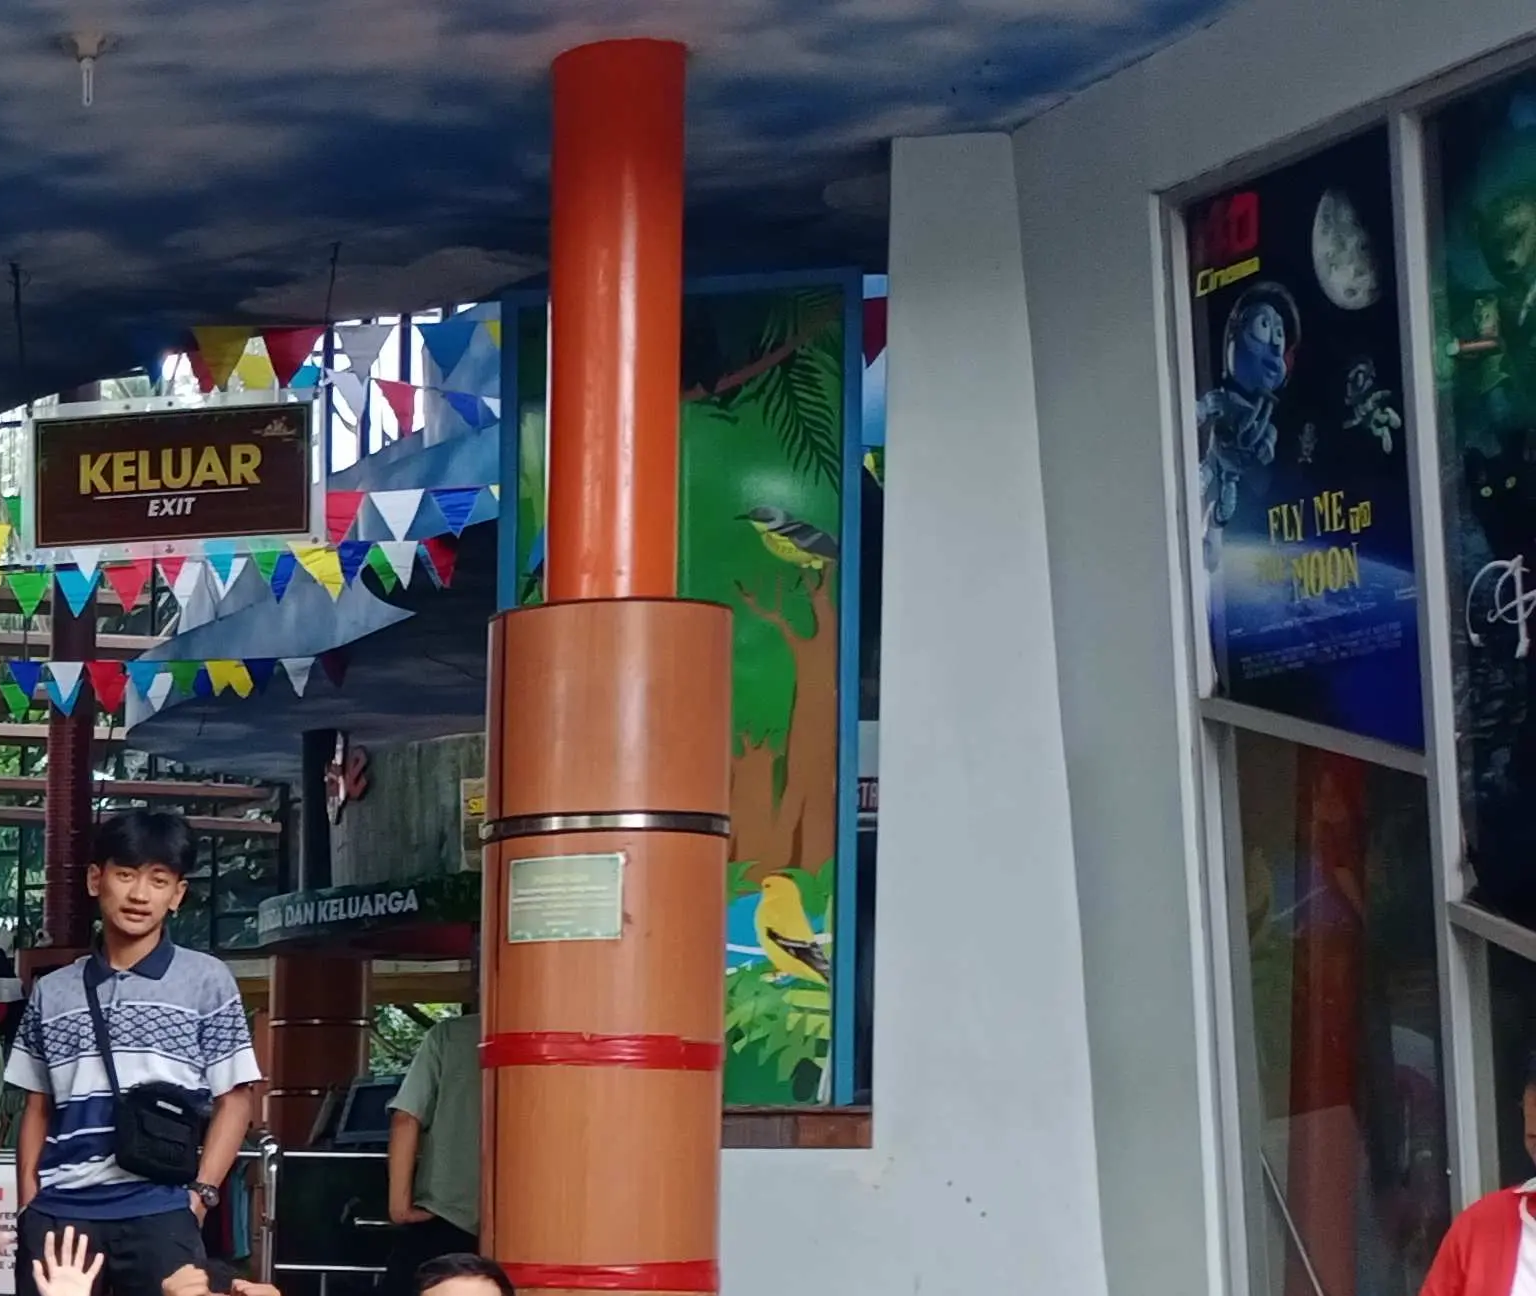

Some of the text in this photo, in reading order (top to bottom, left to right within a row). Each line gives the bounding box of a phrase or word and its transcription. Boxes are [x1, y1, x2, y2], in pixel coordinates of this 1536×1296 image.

[79, 444, 261, 495] KELUAR
[147, 497, 197, 517] EXIT
[1268, 498, 1304, 546] FLY
[1312, 489, 1346, 537] ME
[1291, 541, 1361, 604] MOON
[284, 902, 315, 928] DAN
[317, 888, 419, 923] KELUARGA
